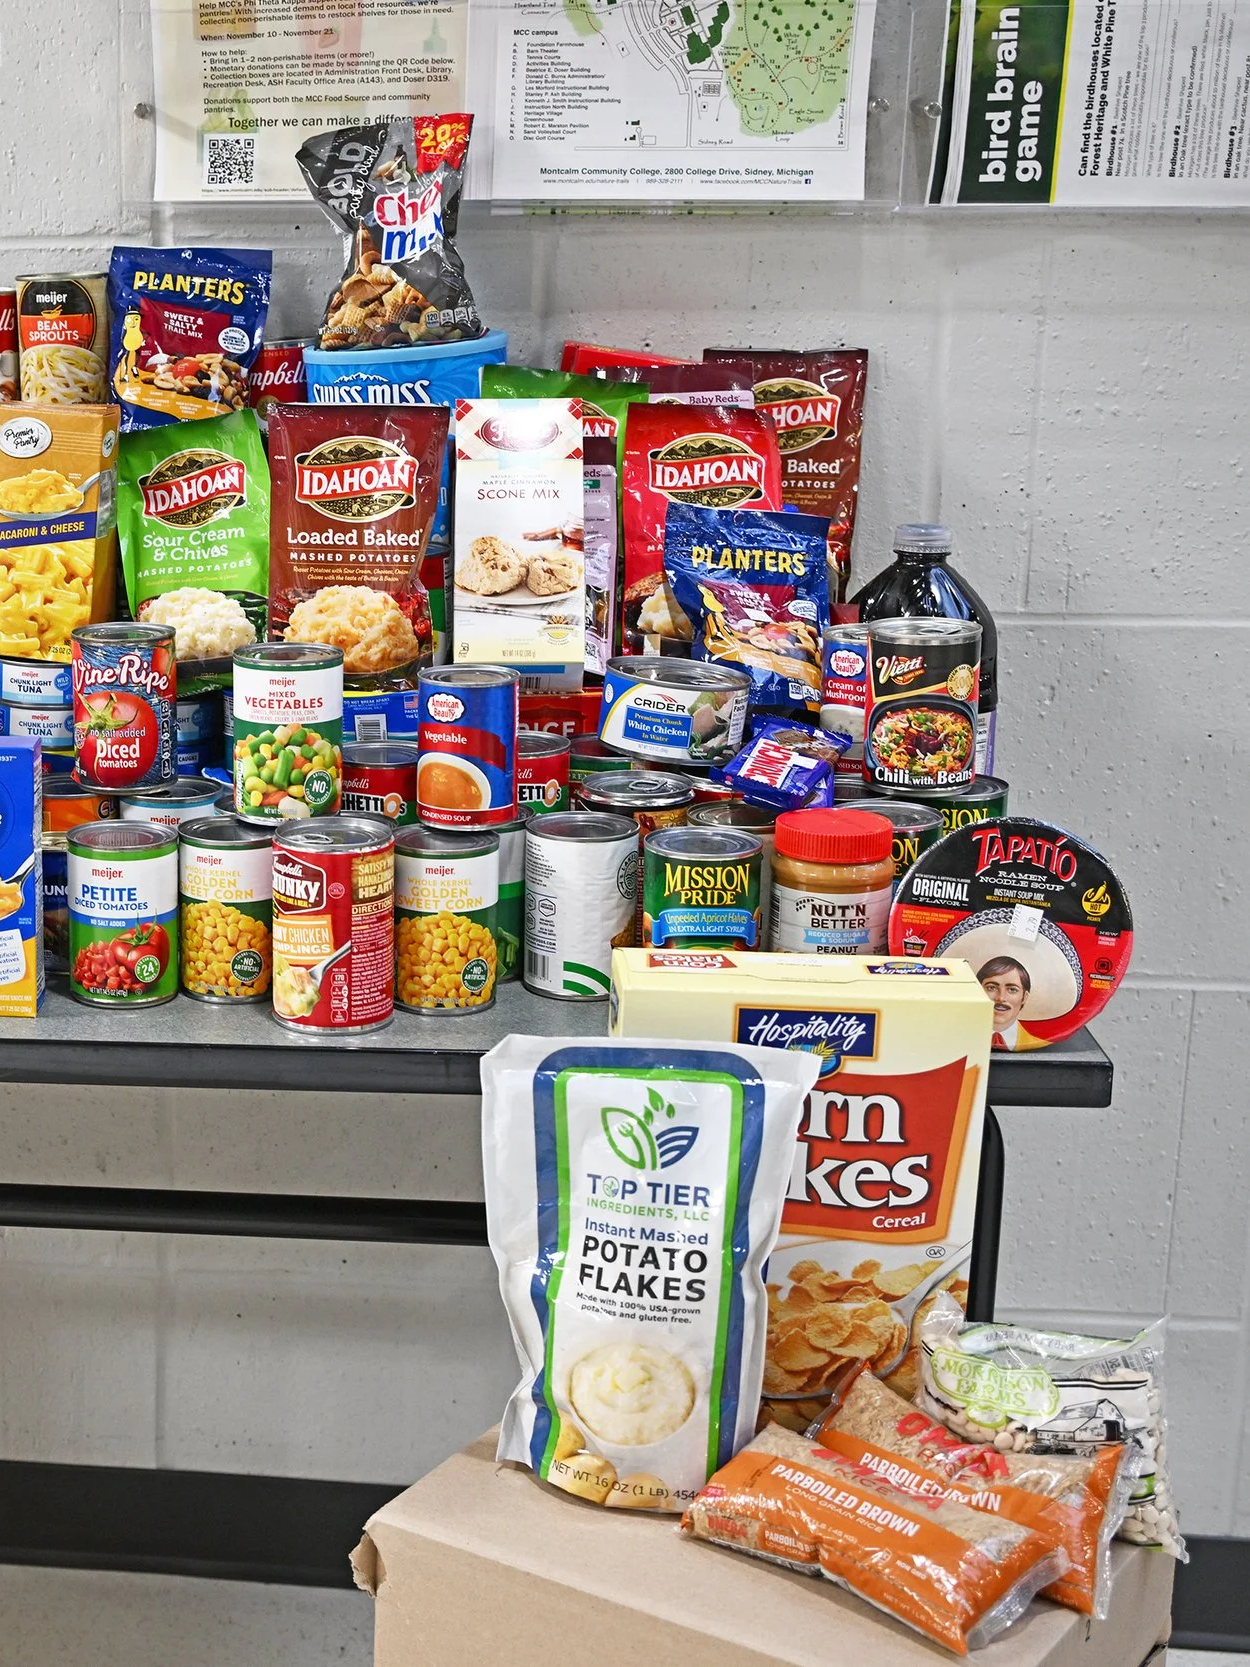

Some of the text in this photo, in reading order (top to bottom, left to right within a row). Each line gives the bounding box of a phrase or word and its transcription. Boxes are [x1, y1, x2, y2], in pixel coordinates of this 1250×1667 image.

[200, 34, 225, 42] When:
[227, 31, 265, 40] November
[267, 30, 277, 38] 10
[282, 29, 323, 37] November
[531, 29, 559, 37] campus
[201, 50, 218, 58] How
[229, 49, 247, 58] help:
[209, 57, 230, 66] Bring
[231, 56, 239, 64] in
[257, 53, 312, 64] non-perishable
[314, 52, 336, 61] items
[337, 51, 347, 60] (or
[978, 7, 1021, 183] bird brain
[1078, 4, 1105, 177] Can find the birdhouses located
[1089, 8, 1117, 177] Forest Heritage and White Pine
[228, 115, 371, 130] Together we can make a
[1015, 80, 1043, 183] game
[540, 167, 579, 176] Montcalm
[581, 167, 628, 178] Community
[630, 167, 663, 178] College,
[664, 168, 684, 176] 2800
[686, 167, 717, 178] College
[776, 167, 814, 178] Michigan
[133, 270, 246, 305] PLANTERS
[36, 292, 68, 306] meijer
[37, 320, 69, 332] BEAN
[28, 330, 80, 341] SPROUTS
[688, 392, 738, 408] Baby Reds
[301, 464, 412, 498] IDAHOAN
[654, 458, 762, 490] IDAHOAN
[147, 466, 244, 516] IDAHOAN
[477, 487, 561, 502] SCONE MIX
[40, 526, 49, 537] &
[50, 521, 85, 535] CHEESE
[286, 526, 421, 549] Loaded Baked
[289, 551, 417, 566] MASHED POTATOES
[690, 545, 807, 578] PLANTERS
[875, 654, 924, 684] Vietti
[9, 677, 31, 685] CHUNK
[17, 684, 43, 694] TUNA
[268, 677, 296, 688] meijer
[244, 696, 325, 710] VEGETABLES
[633, 696, 687, 713] CRIDER
[627, 718, 689, 738] White Chicken
[424, 729, 468, 745] Vegetable
[98, 757, 138, 769] tomatoes
[874, 765, 974, 786] Chili with Beans
[421, 809, 472, 823] CONDENSED SOUP
[972, 827, 1078, 881] TAPATÍO
[424, 865, 455, 878] meijer
[997, 870, 1048, 883] RAMEN
[663, 862, 750, 898] MISSION
[979, 875, 1065, 892] NOODLE SOUP
[80, 884, 138, 903] PETITE
[410, 884, 469, 899] GOLDEN
[679, 889, 737, 906] PRIDE
[912, 877, 970, 902] ORIGINAL
[97, 900, 149, 912] TOMATOES
[398, 895, 483, 910] SWEET CORN
[810, 902, 868, 917] NUT'N
[810, 916, 868, 930] BETTER
[682, 1209, 711, 1223] LLC
[584, 1217, 709, 1247] Instant Mashed
[581, 1234, 709, 1274] POTATO
[578, 1262, 708, 1303] FLAKES
[770, 1463, 921, 1539] PARBOILED BROWN
